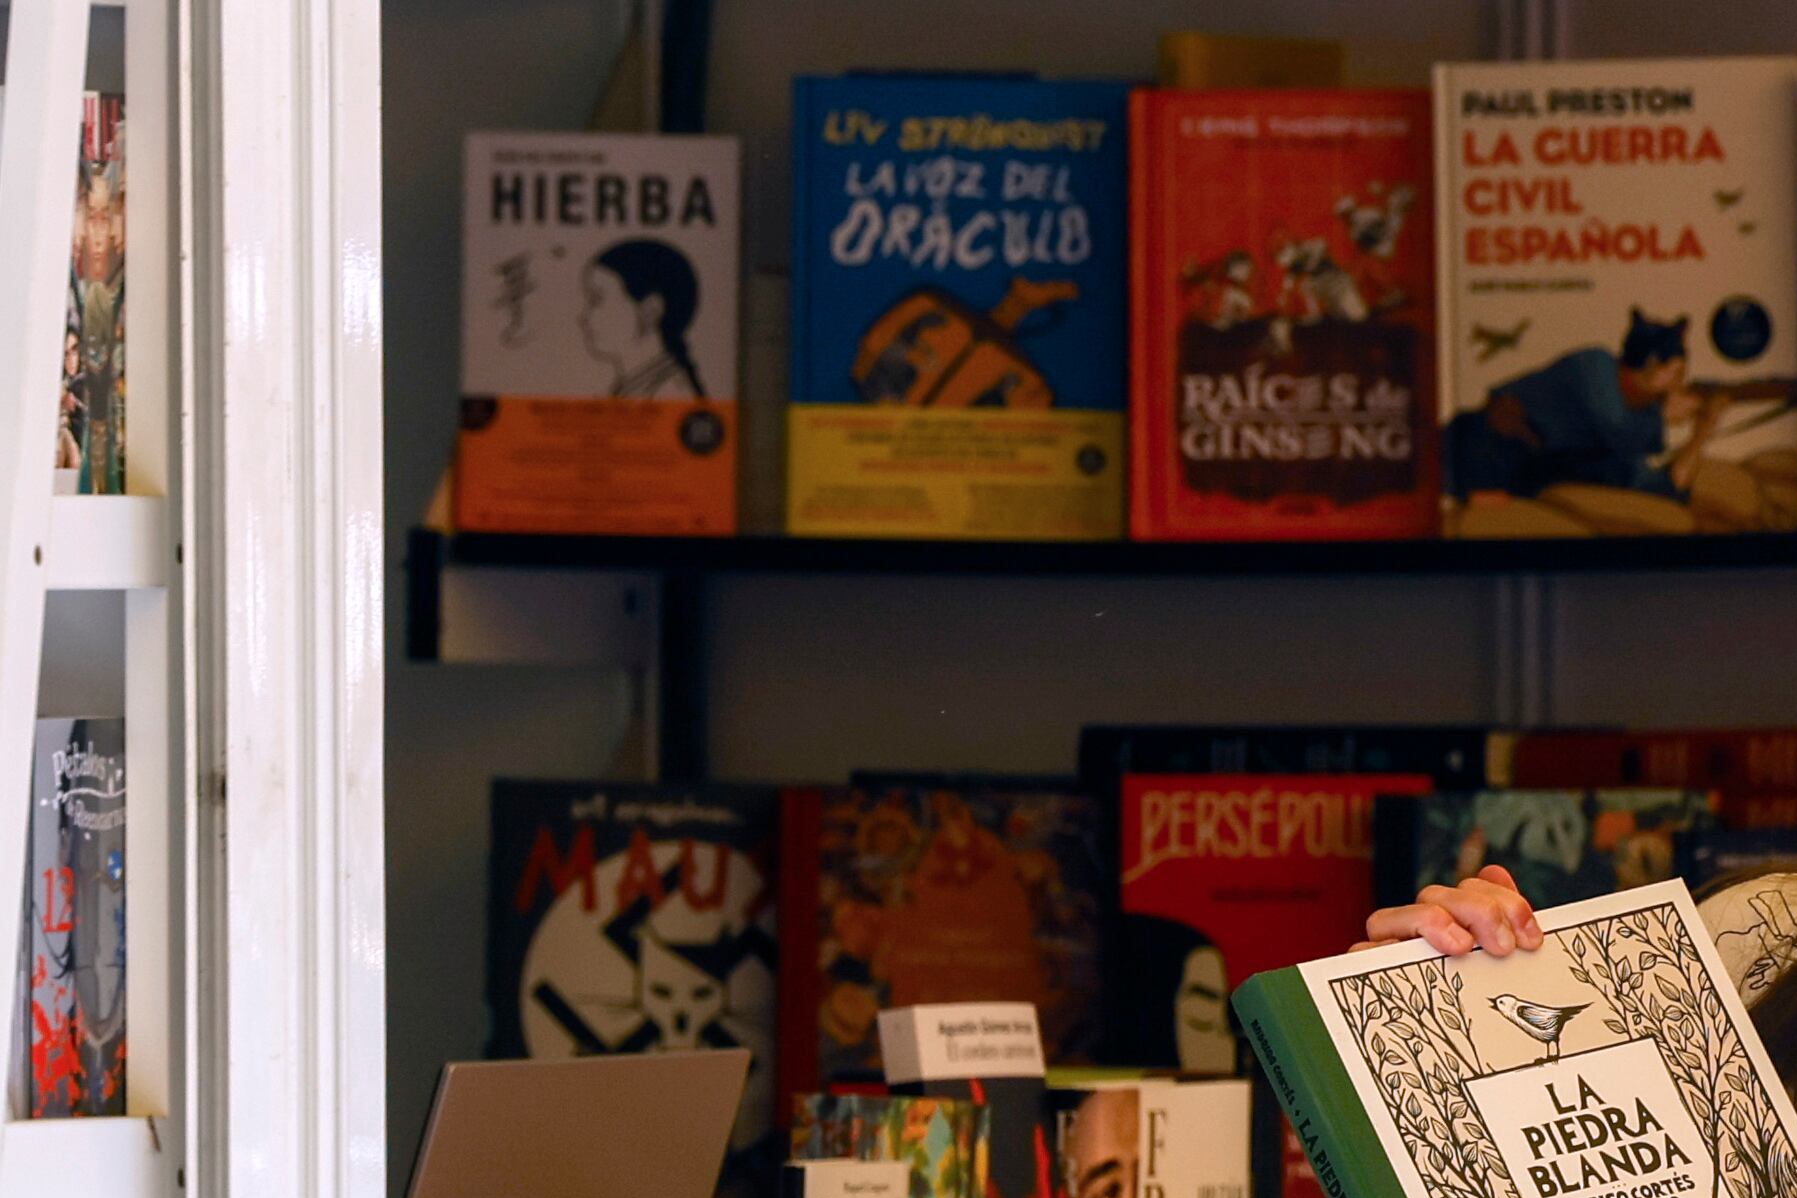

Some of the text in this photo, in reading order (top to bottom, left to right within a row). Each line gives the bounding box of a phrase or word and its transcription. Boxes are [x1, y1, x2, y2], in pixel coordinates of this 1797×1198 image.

[1462, 87, 1693, 117] PAUL PRESTON
[1463, 126, 1724, 166] LA GUERRA
[845, 159, 896, 198] LA
[1463, 178, 1582, 215] CIVIL
[492, 174, 716, 226] HIERBA
[1465, 218, 1705, 263] ESPAÑOLA
[1182, 361, 1360, 412] RAÍCES
[1181, 422, 1412, 460] GINSENG
[1544, 1074, 1607, 1115] LA
[1299, 1118, 1318, 1153] LA
[1521, 1097, 1664, 1160] PIEDRA
[1527, 1133, 1693, 1198] BLANDA
